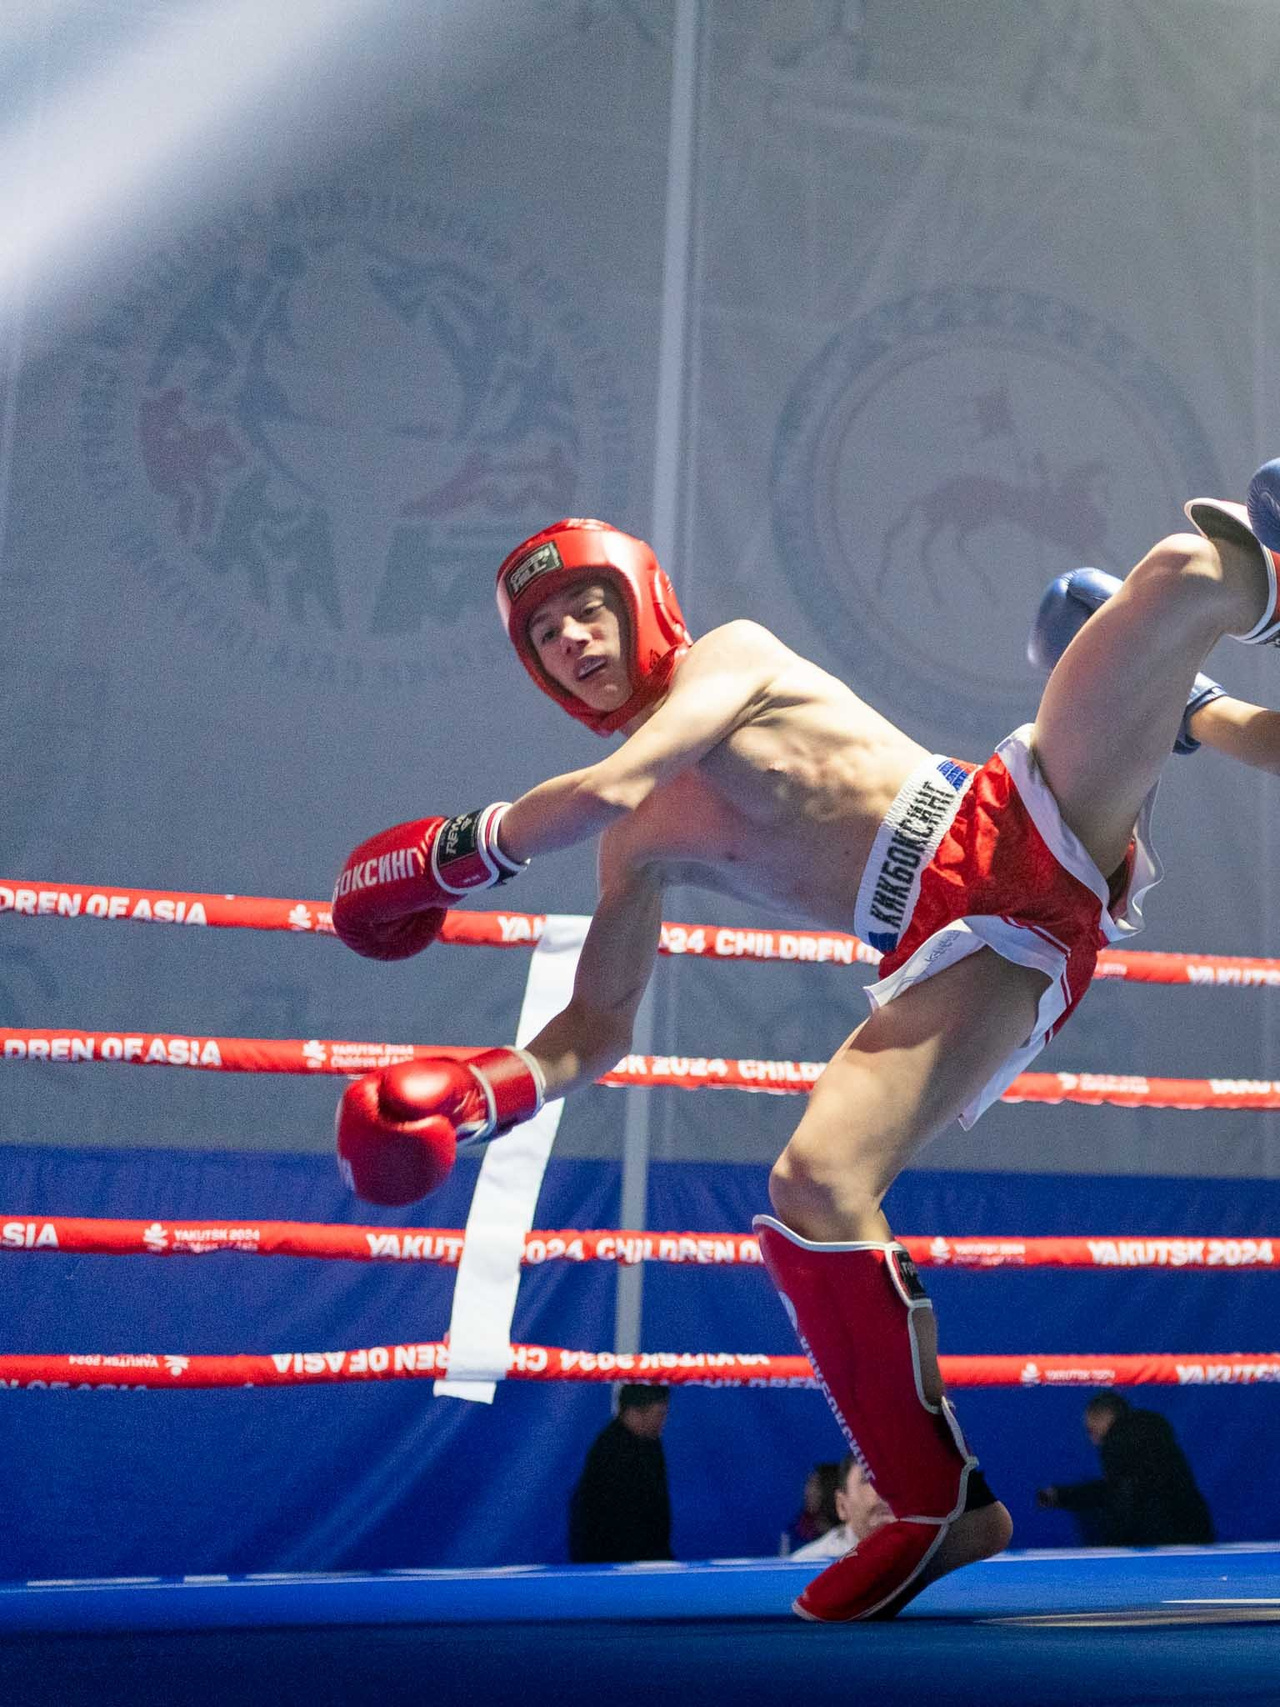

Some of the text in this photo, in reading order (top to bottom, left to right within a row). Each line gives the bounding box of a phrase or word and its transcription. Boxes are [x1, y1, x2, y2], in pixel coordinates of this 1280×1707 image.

[869, 781, 955, 929] КИКБОКСИНГ
[86, 893, 130, 919] OF
[132, 899, 208, 925] ASIA
[716, 930, 854, 963] CHILDREN
[101, 1036, 144, 1061] OF
[145, 1038, 223, 1067] ASIA
[521, 1238, 585, 1264] 024
[596, 1237, 735, 1264] CHILDREN
[1087, 1240, 1206, 1266] YAKUTSK
[1207, 1241, 1274, 1266] 2024
[271, 1350, 347, 1374] ASIA
[350, 1346, 390, 1373] OF
